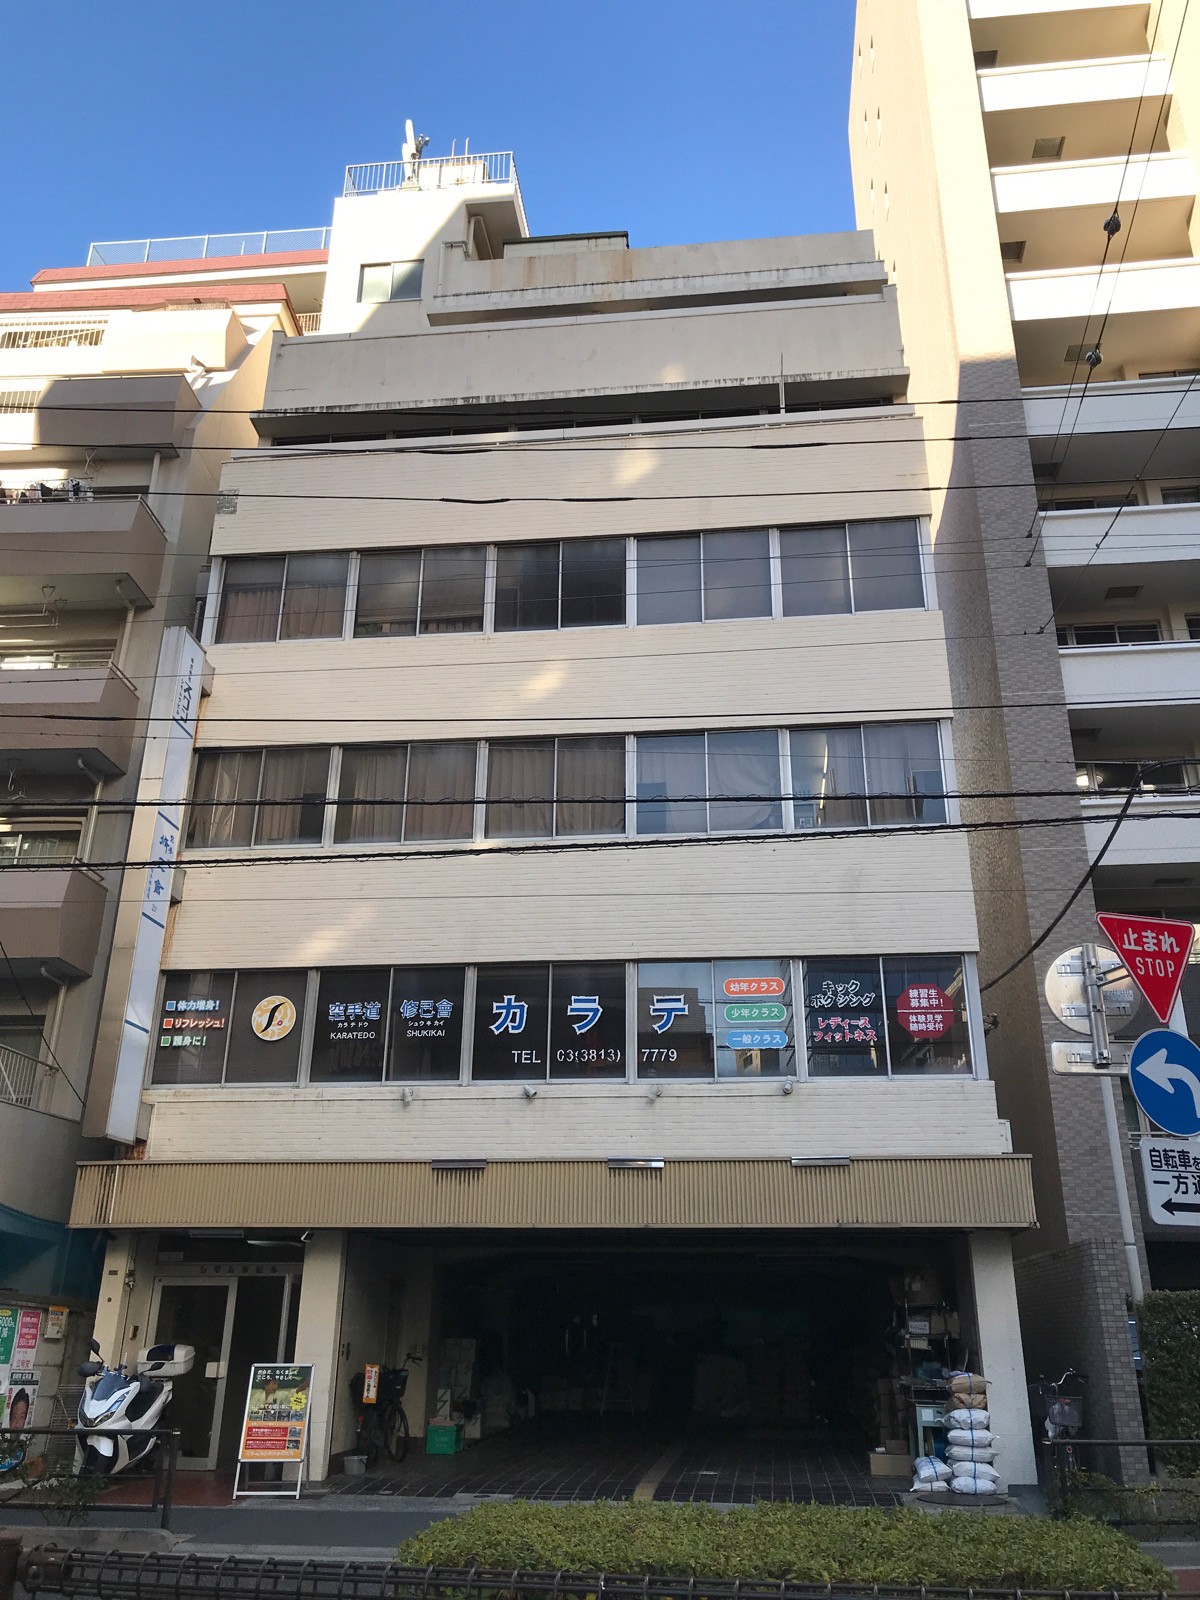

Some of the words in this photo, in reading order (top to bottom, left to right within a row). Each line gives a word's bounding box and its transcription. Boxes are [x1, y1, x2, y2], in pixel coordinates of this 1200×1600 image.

[1122, 927, 1181, 954] 止まれ
[1135, 956, 1175, 978] STOP
[729, 981, 779, 992] 幼年クラス
[821, 980, 861, 994] キック
[810, 992, 876, 1008] ボクシング
[908, 988, 939, 999] 練習生
[328, 1001, 382, 1022] 空手道
[731, 1007, 780, 1018] 少年クラス
[817, 1016, 871, 1029] レディース
[908, 1014, 943, 1023] 体験見学
[330, 1031, 376, 1040] KARATEDO
[406, 1029, 446, 1038] SHUKIKAI
[732, 1034, 782, 1045] 一般クラス
[812, 1028, 878, 1042] フィットネス
[511, 1050, 541, 1064] TEL
[641, 1048, 677, 1062] 7779
